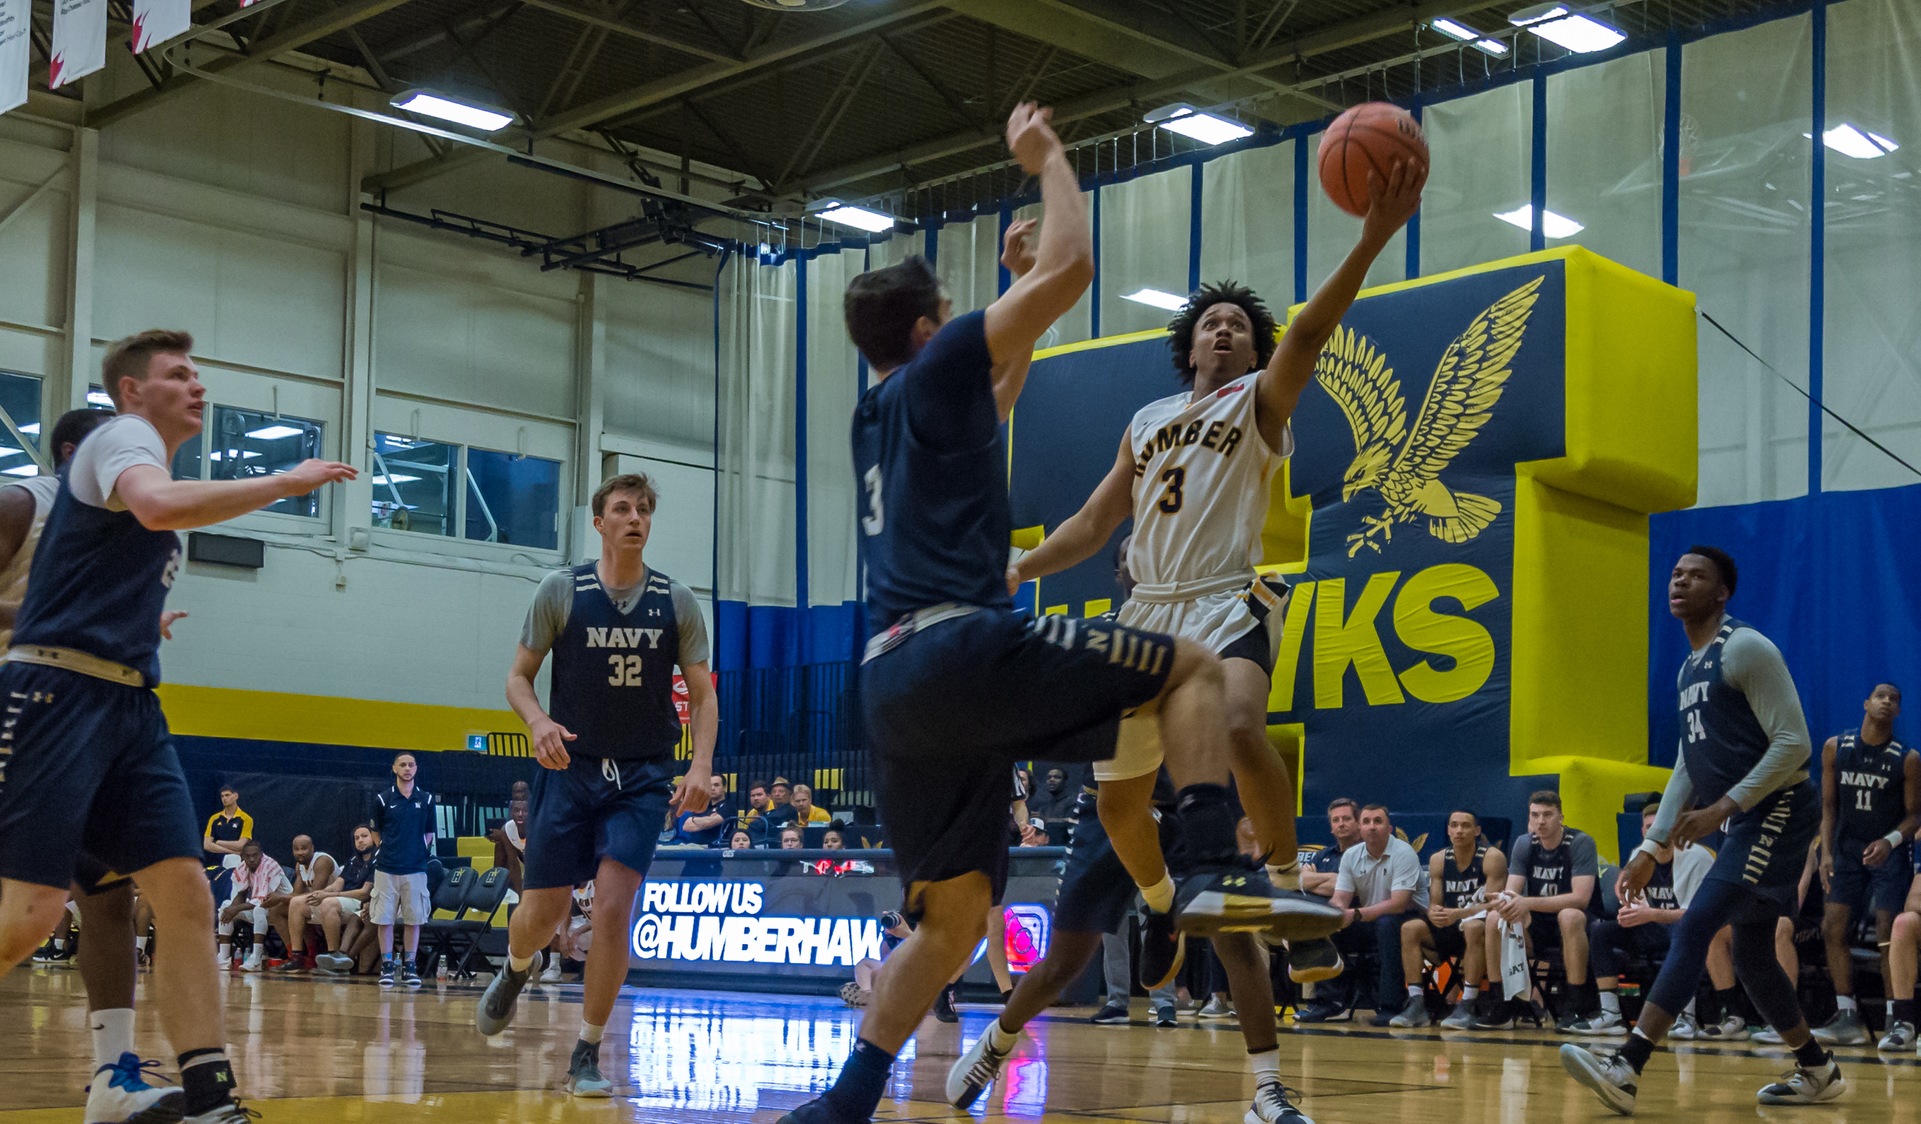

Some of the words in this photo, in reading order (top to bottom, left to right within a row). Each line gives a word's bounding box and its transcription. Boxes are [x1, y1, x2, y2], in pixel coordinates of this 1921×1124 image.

[862, 464, 884, 536] 3
[1158, 465, 1185, 515] 3
[586, 627, 664, 649] NAVY
[607, 654, 643, 687] 32
[1687, 709, 1707, 744] 34
[1840, 771, 1889, 790] NAVY
[1855, 789, 1873, 811] 11
[1533, 865, 1564, 879] NAVY
[1445, 878, 1479, 893] NAVY
[1646, 887, 1675, 900] NAV
[642, 882, 731, 914] FOLLOW
[731, 883, 763, 915] US
